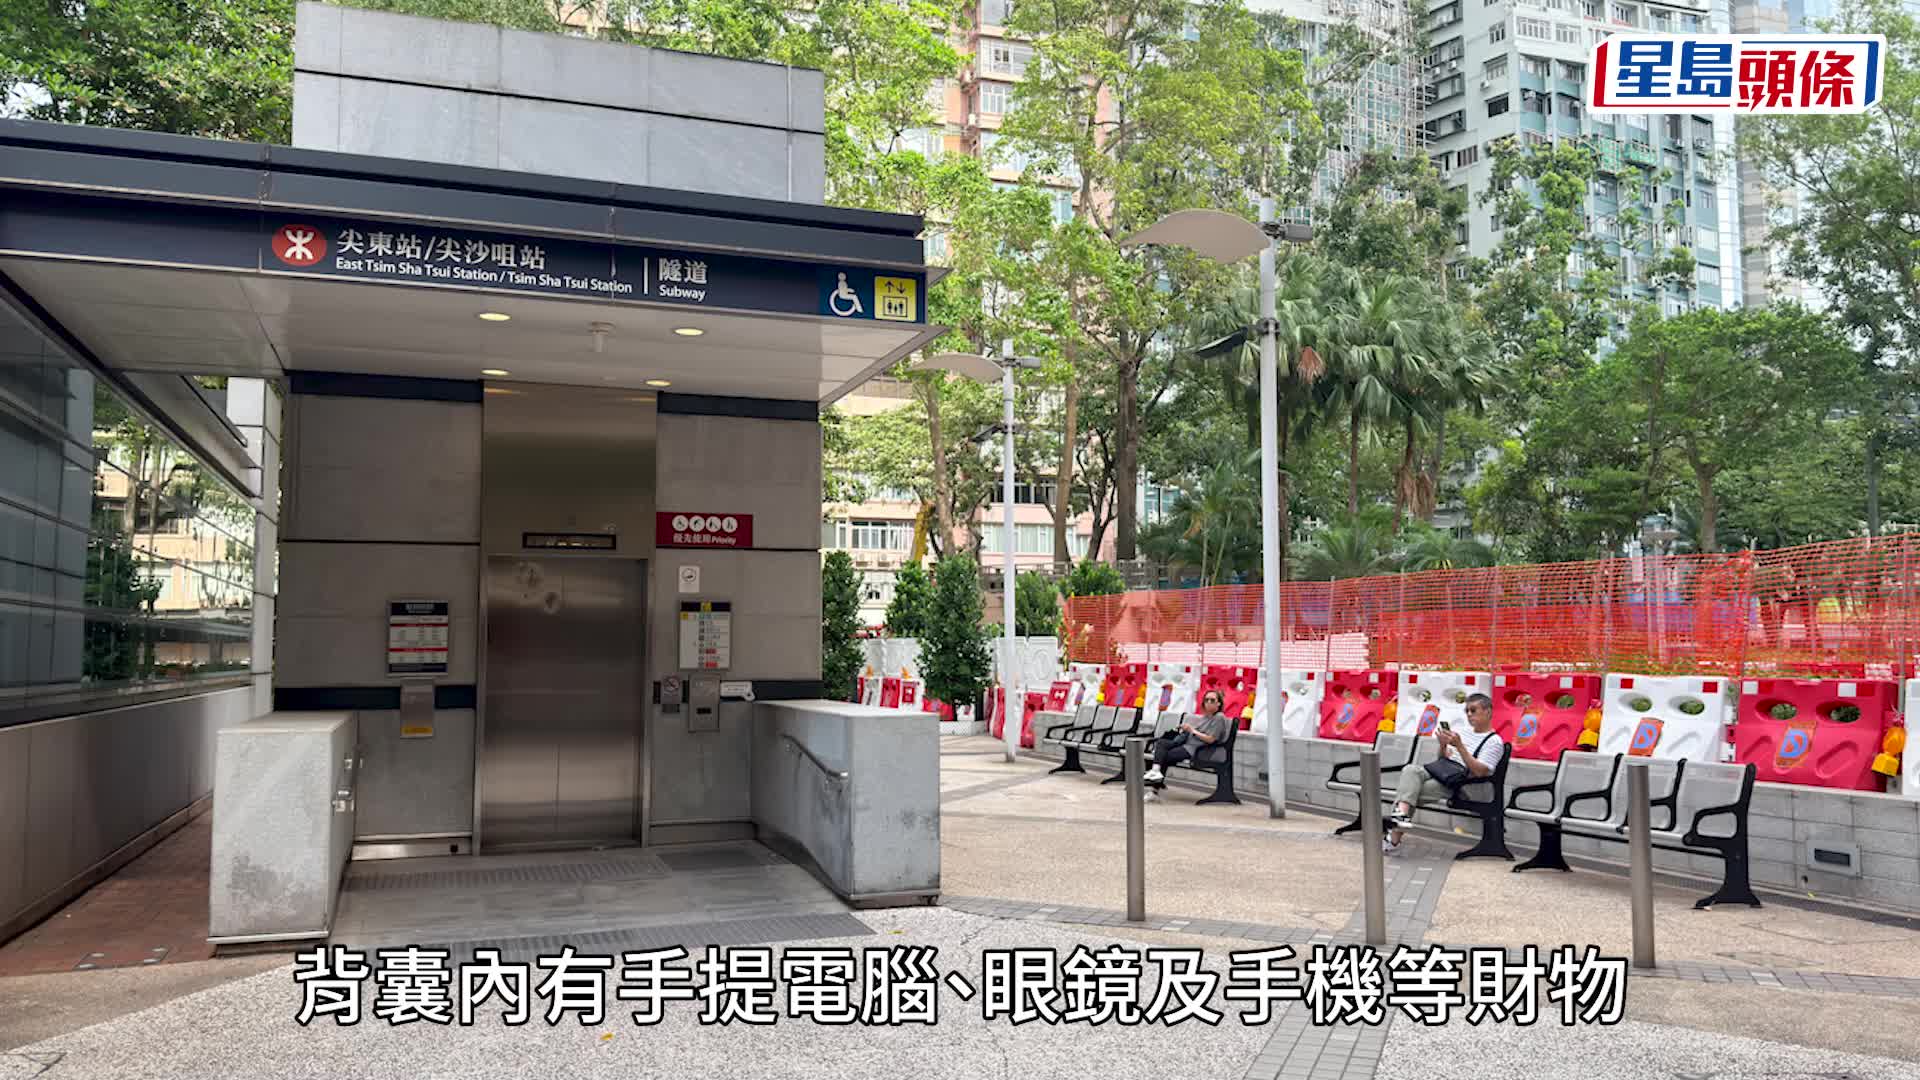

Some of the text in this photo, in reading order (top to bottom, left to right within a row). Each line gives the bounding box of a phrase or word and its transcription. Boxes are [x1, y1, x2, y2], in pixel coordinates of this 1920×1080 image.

[336, 228, 546, 270] 尖東站/尖沙咀站
[336, 256, 363, 271] East
[365, 259, 396, 274] Tsim
[398, 261, 422, 276] Sha
[424, 263, 451, 278] Tsui
[453, 266, 497, 282] Station
[507, 270, 536, 285] Tsim
[539, 274, 562, 288] Sha
[563, 275, 588, 291] Tsui
[590, 278, 632, 293] Station
[659, 257, 708, 284] 隧道
[659, 284, 706, 302] Subway
